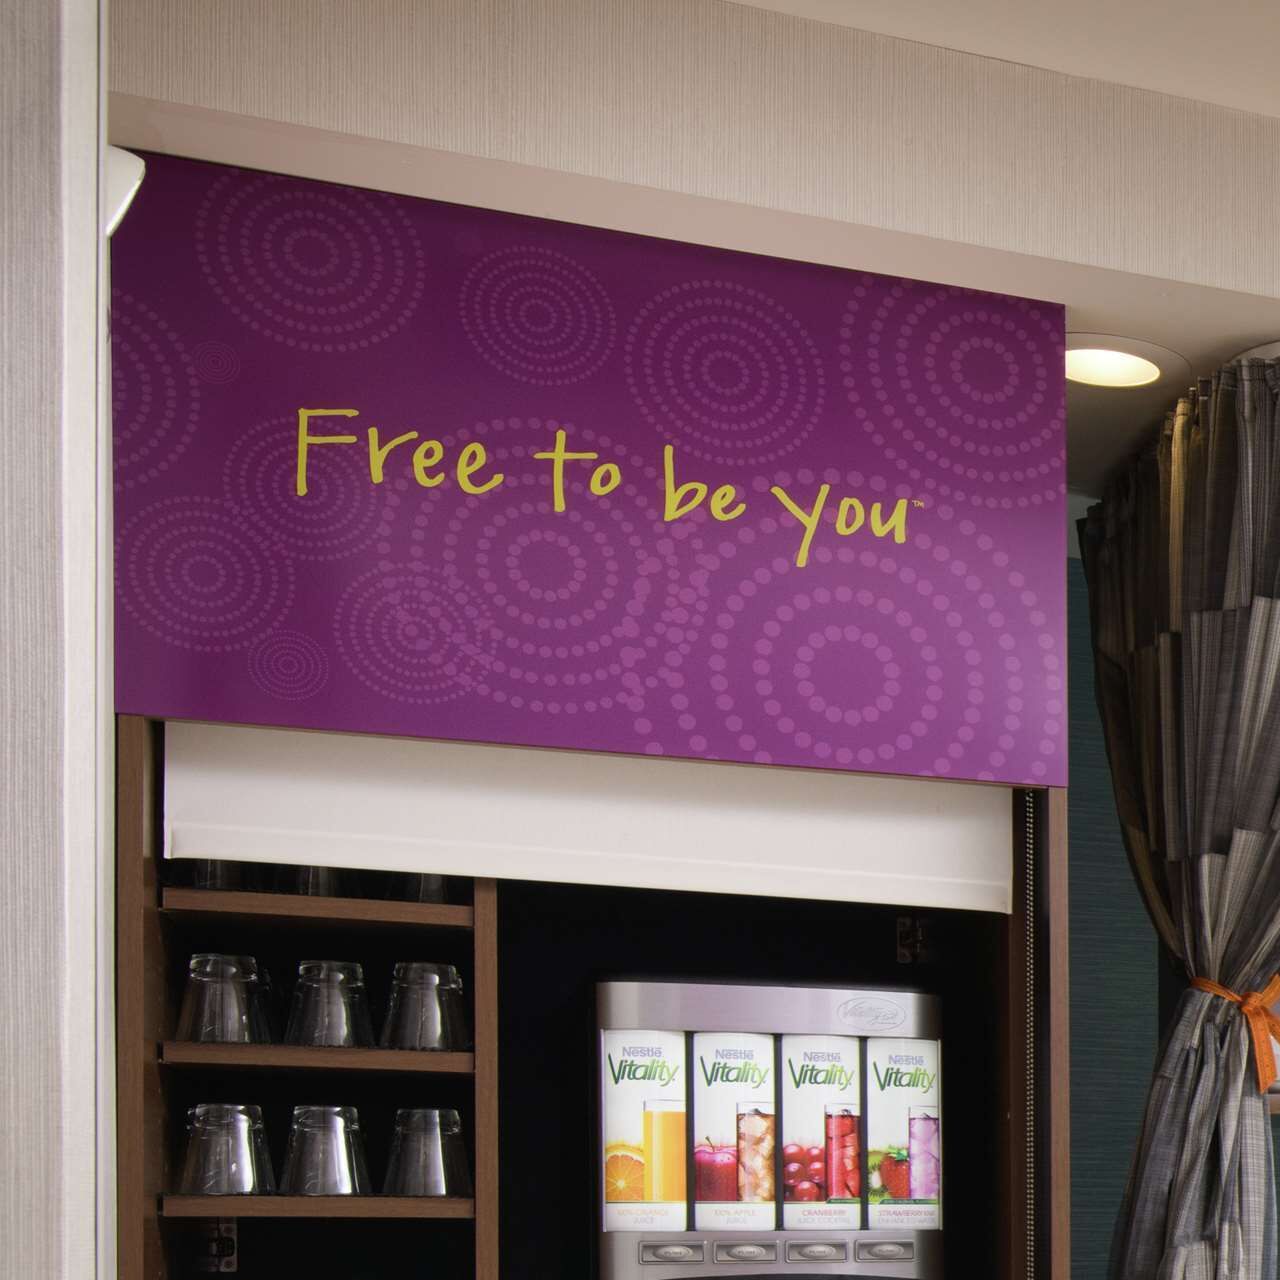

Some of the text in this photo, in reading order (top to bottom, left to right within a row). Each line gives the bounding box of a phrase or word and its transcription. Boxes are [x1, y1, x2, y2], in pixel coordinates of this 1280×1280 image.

[297, 407, 504, 497] Free
[533, 429, 621, 512] to
[663, 444, 746, 521] be
[608, 1052, 679, 1088] Vitality
[700, 1055, 769, 1089] Vitality
[788, 1057, 855, 1092] Vitality
[873, 1060, 937, 1094] Vitality
